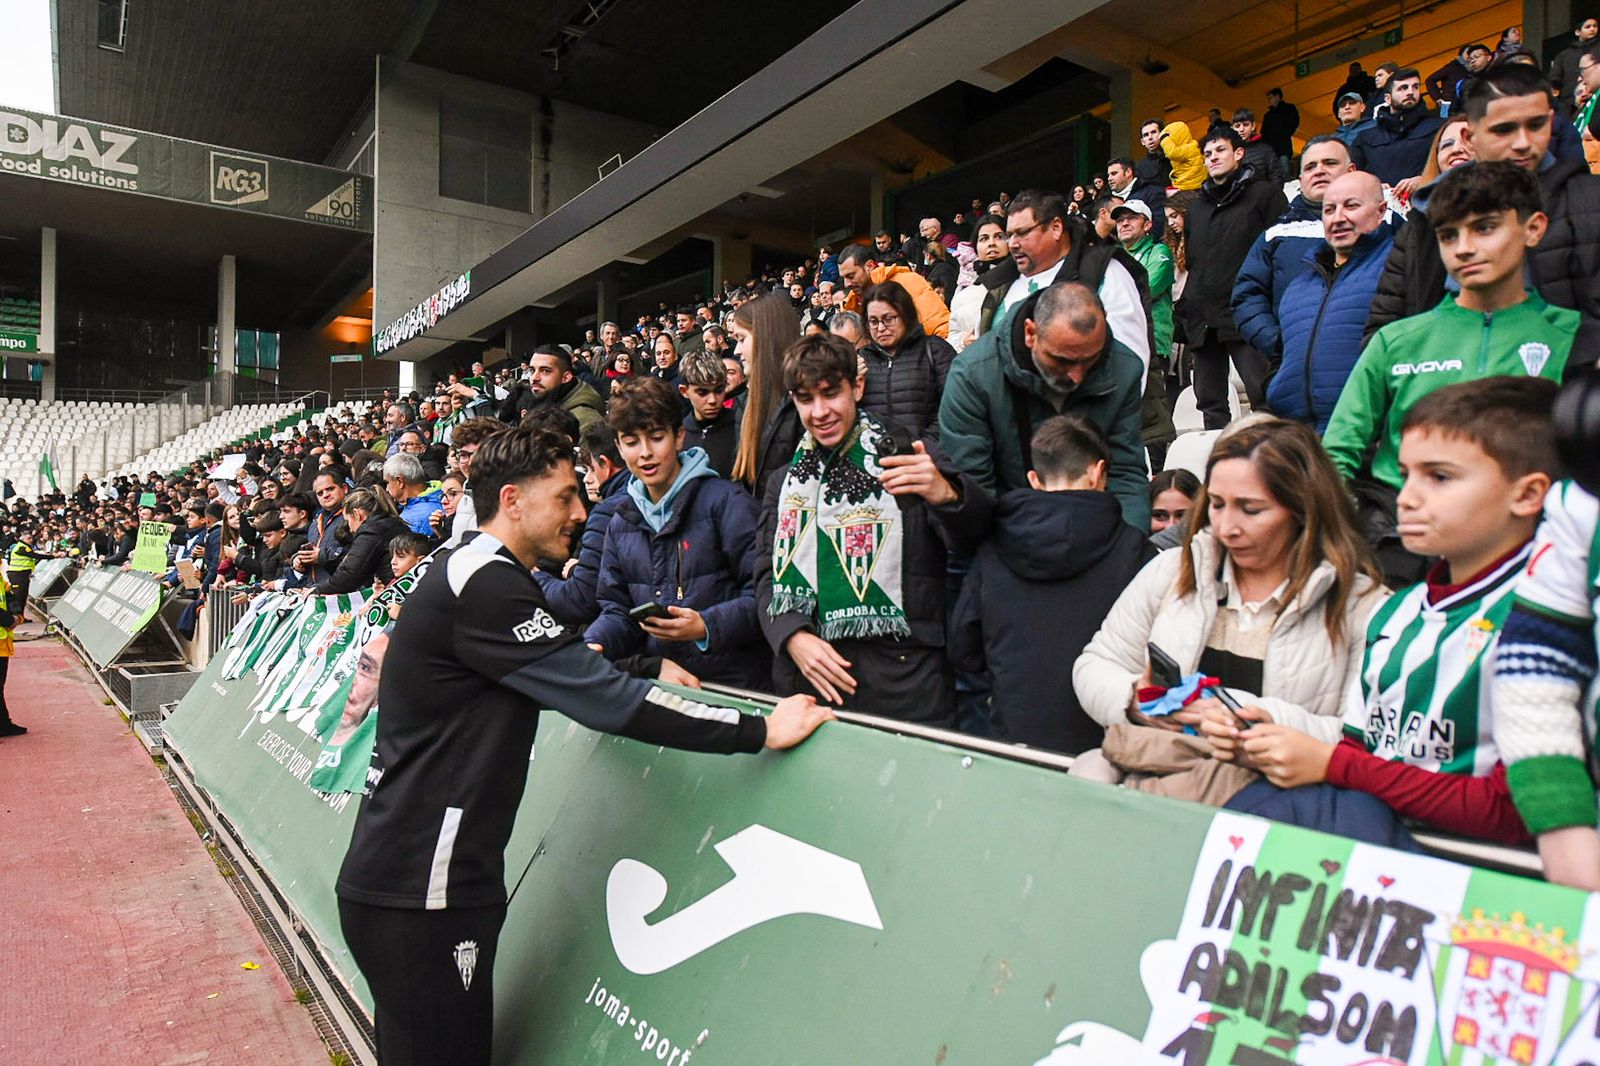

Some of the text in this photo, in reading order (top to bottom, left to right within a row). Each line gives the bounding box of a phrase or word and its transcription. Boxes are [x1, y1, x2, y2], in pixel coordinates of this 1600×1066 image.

[49, 165, 138, 190] solutions
[216, 166, 262, 193] RG3
[329, 200, 353, 218] 90
[1391, 359, 1462, 376] GIVOVA
[825, 605, 877, 621] CORDOBA
[257, 729, 295, 765] EXERCISE
[286, 750, 313, 781] YOUR
